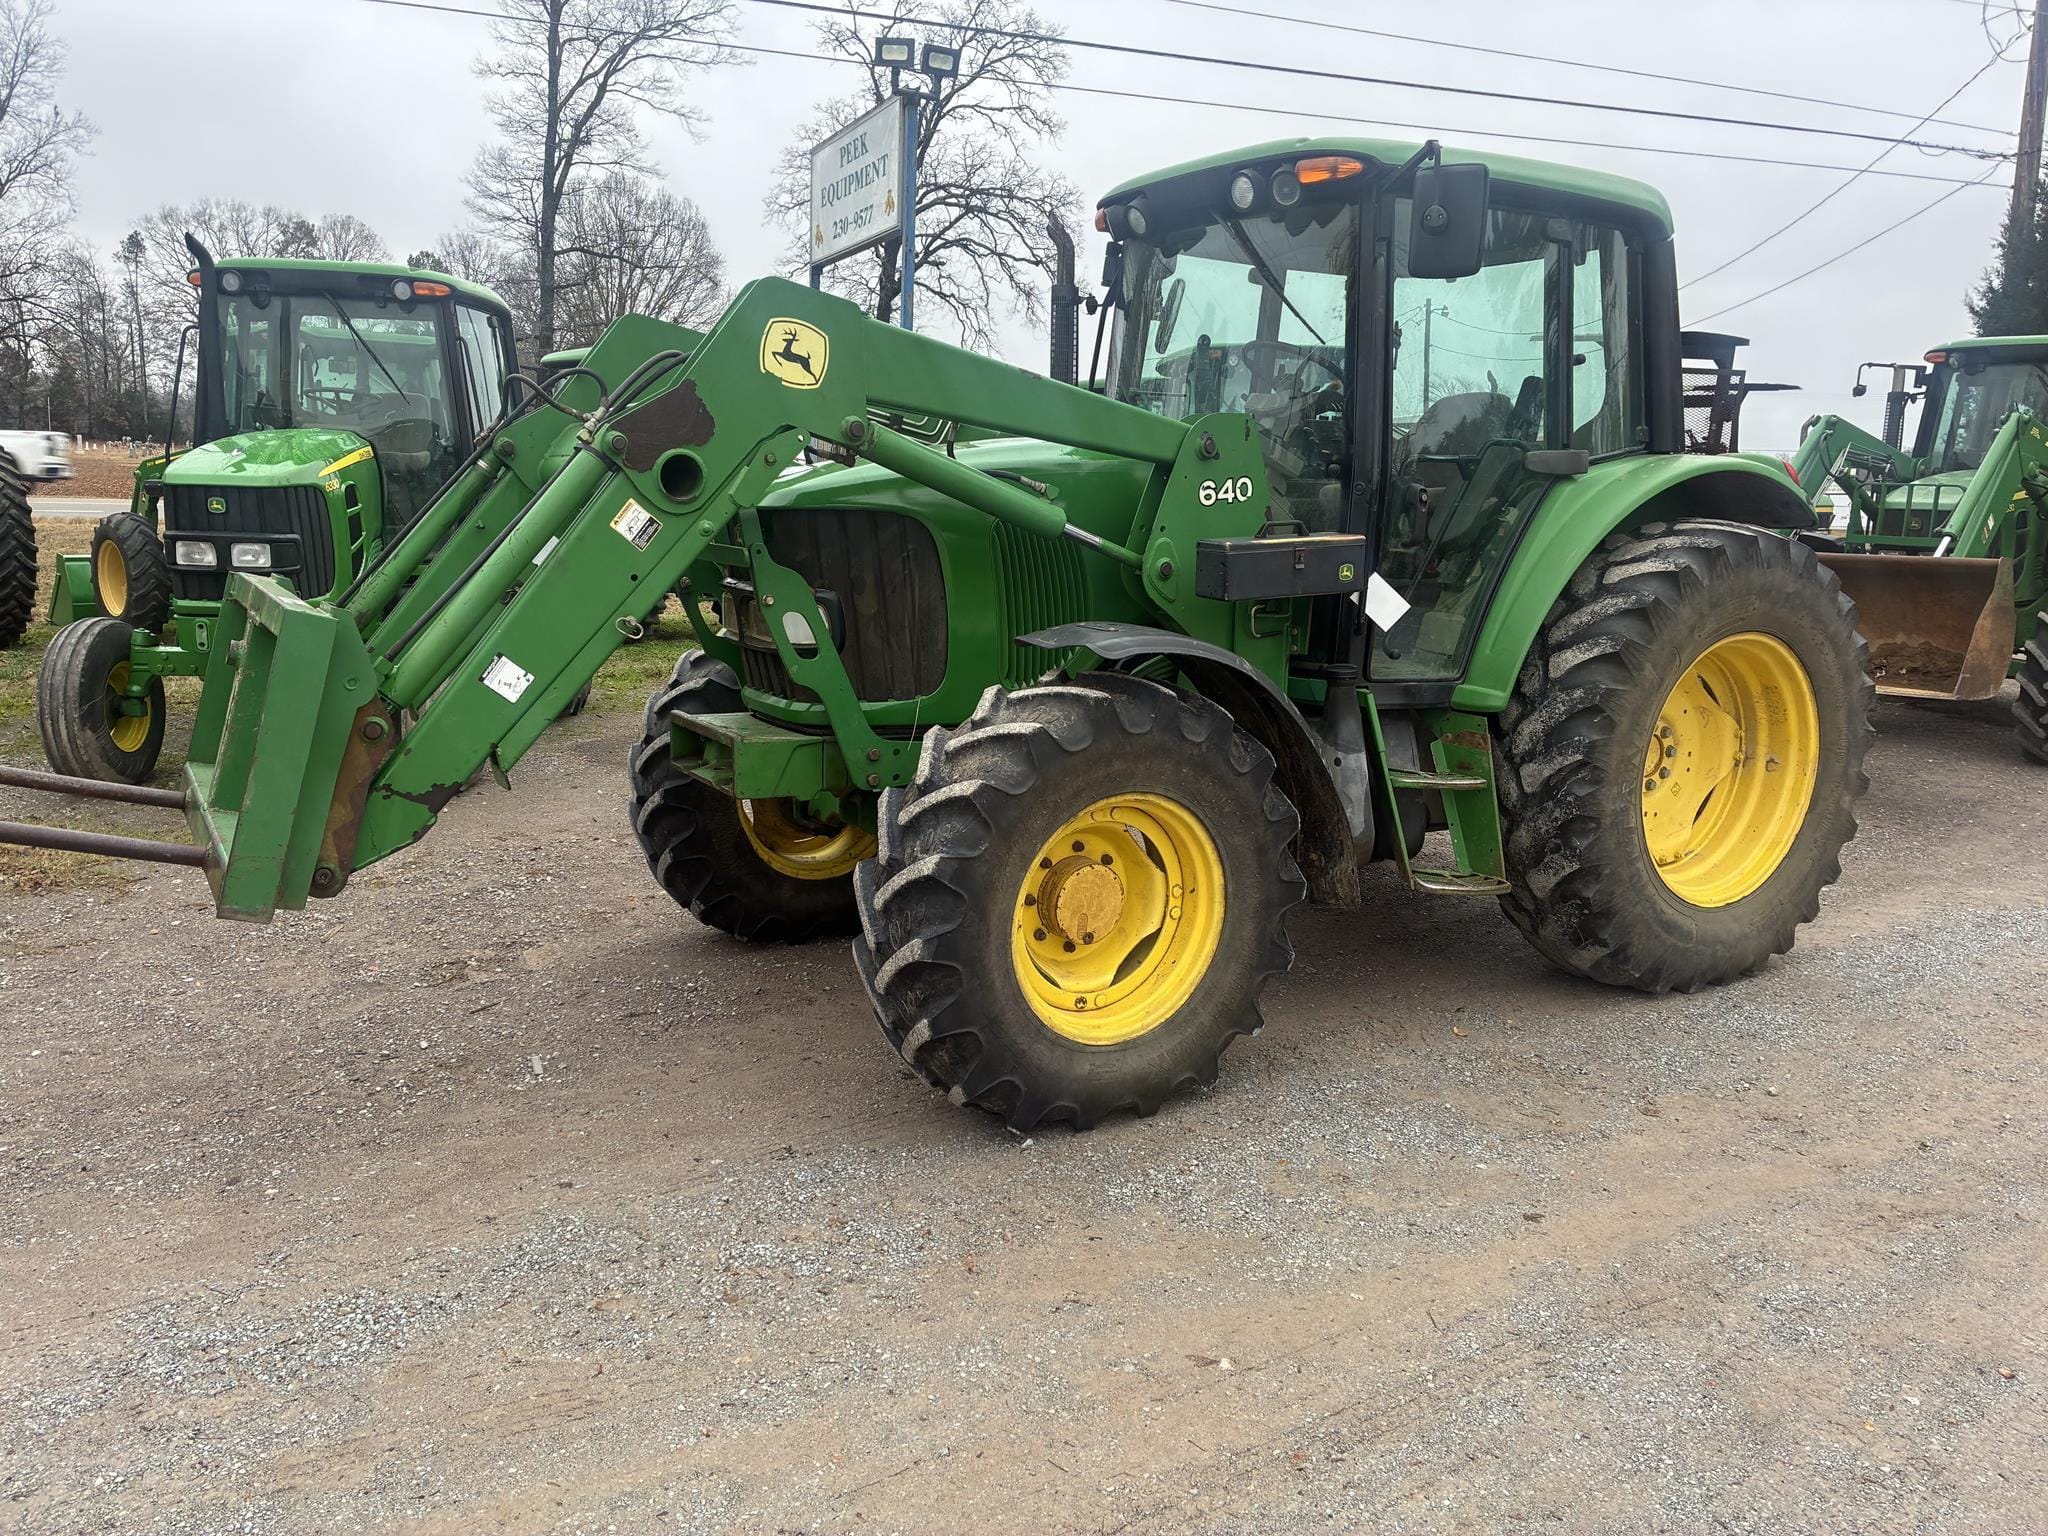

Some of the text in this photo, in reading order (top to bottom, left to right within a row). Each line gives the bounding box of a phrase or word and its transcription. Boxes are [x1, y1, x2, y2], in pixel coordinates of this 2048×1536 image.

[839, 132, 869, 168] PEEK
[820, 153, 889, 209] EQUIPMENT
[832, 203, 874, 240] 230-9577
[1199, 476, 1253, 507] 640
